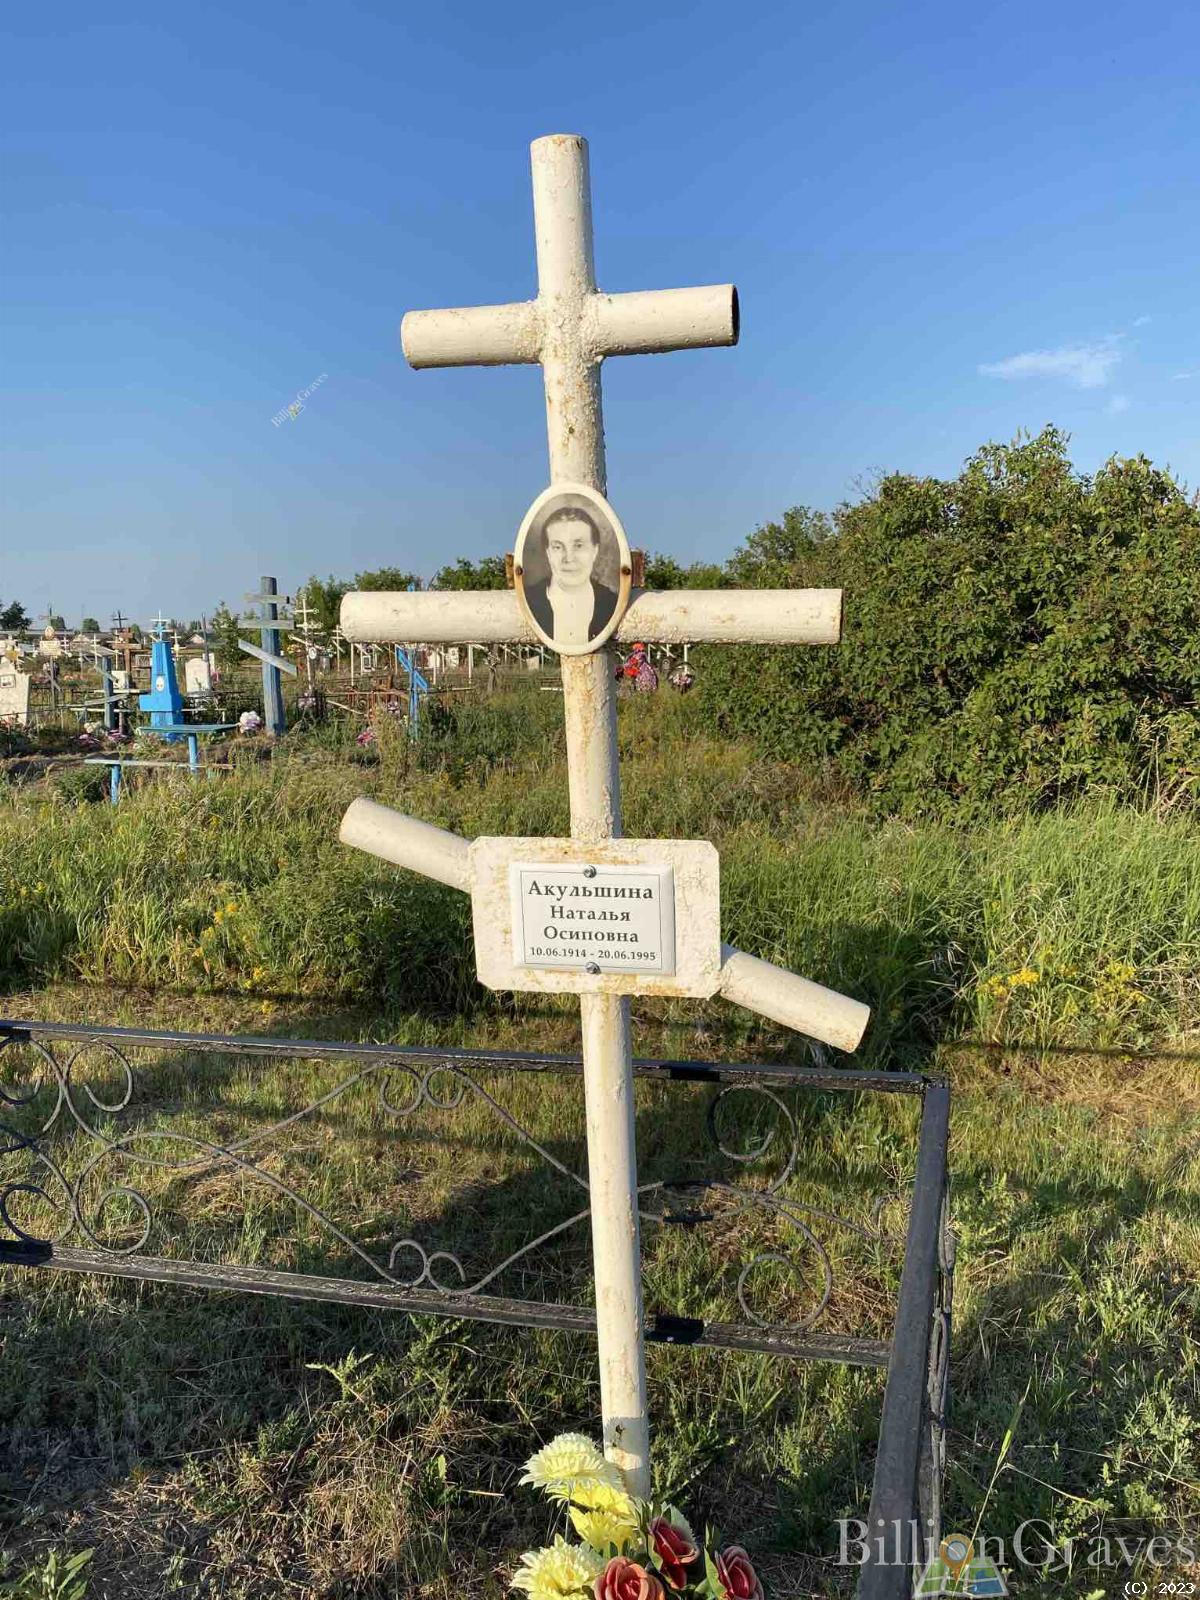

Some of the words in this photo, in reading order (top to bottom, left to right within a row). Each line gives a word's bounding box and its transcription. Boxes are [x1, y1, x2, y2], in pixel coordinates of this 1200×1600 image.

[528, 880, 653, 901] Акульшина
[550, 905, 631, 922] Наталья
[543, 925, 639, 943] Осиповна
[530, 946, 587, 958] 10.06.1914
[598, 950, 656, 961] 20.06.1995
